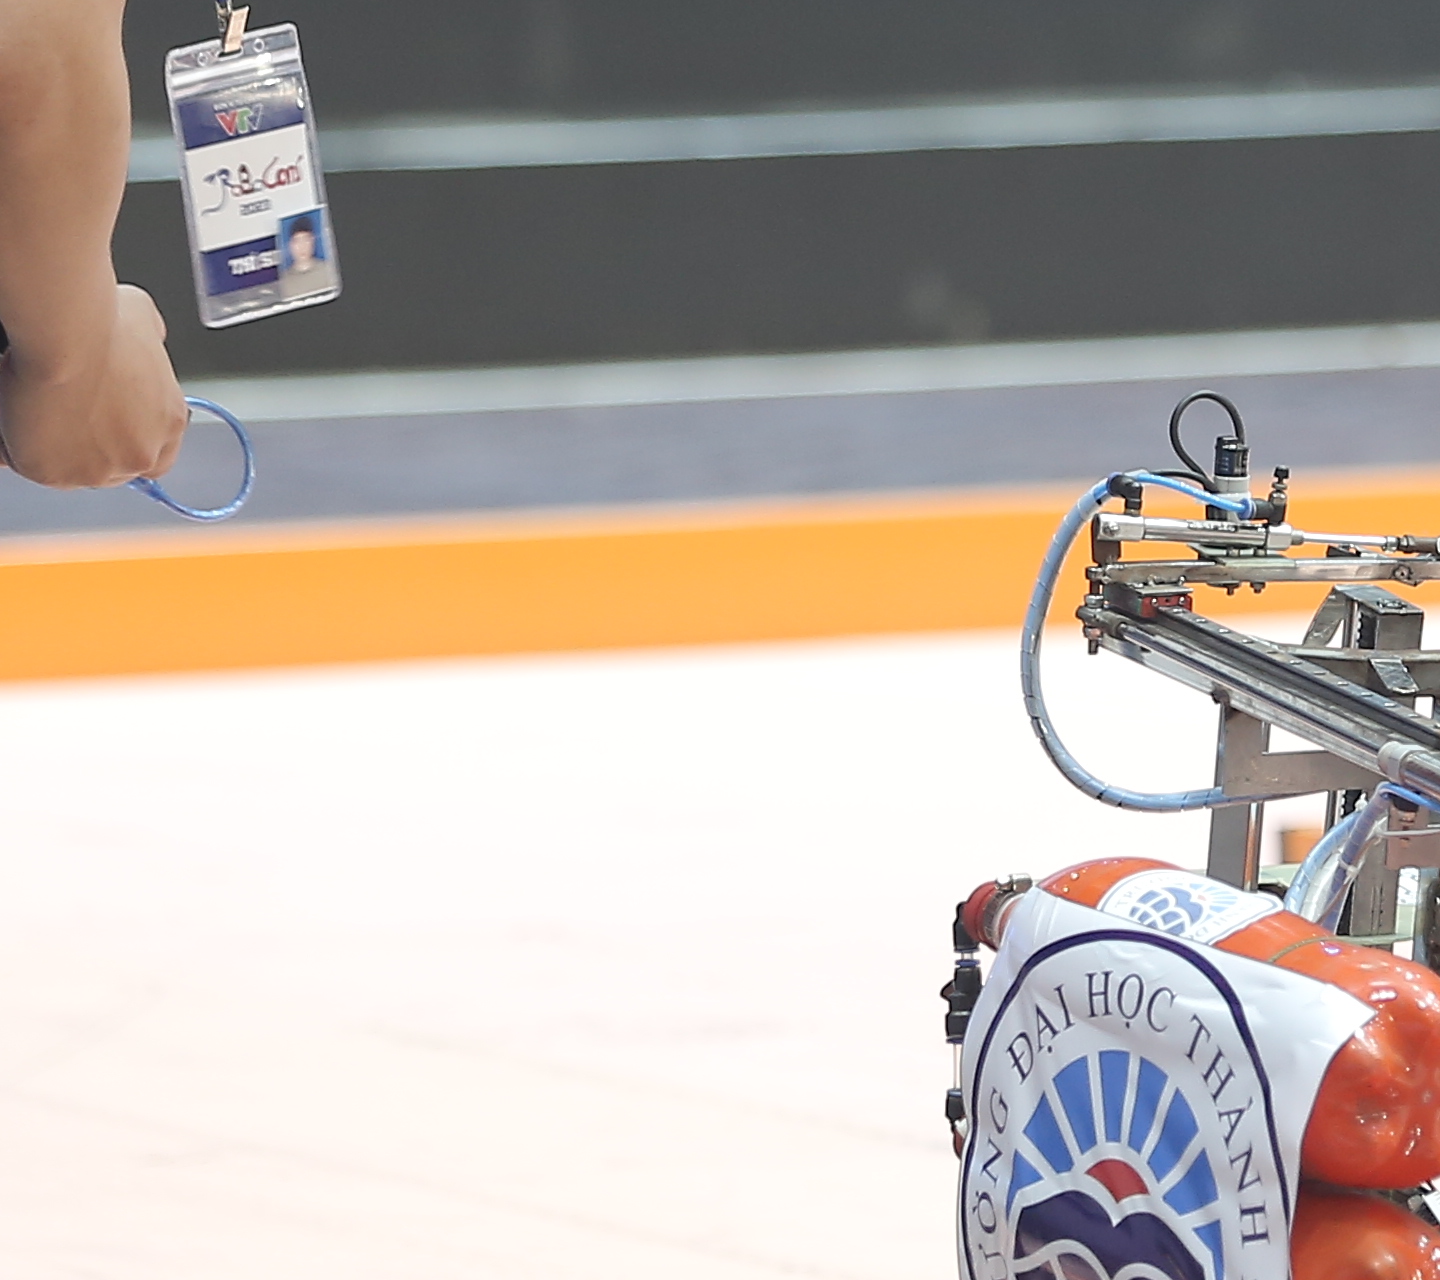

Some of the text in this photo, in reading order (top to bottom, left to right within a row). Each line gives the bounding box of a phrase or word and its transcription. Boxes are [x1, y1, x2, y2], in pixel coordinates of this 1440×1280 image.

[215, 102, 264, 136] VTV
[1005, 983, 1076, 1086] ĐẠI
[1085, 969, 1180, 1034] HỌC
[1184, 1013, 1272, 1249] THÀNH
